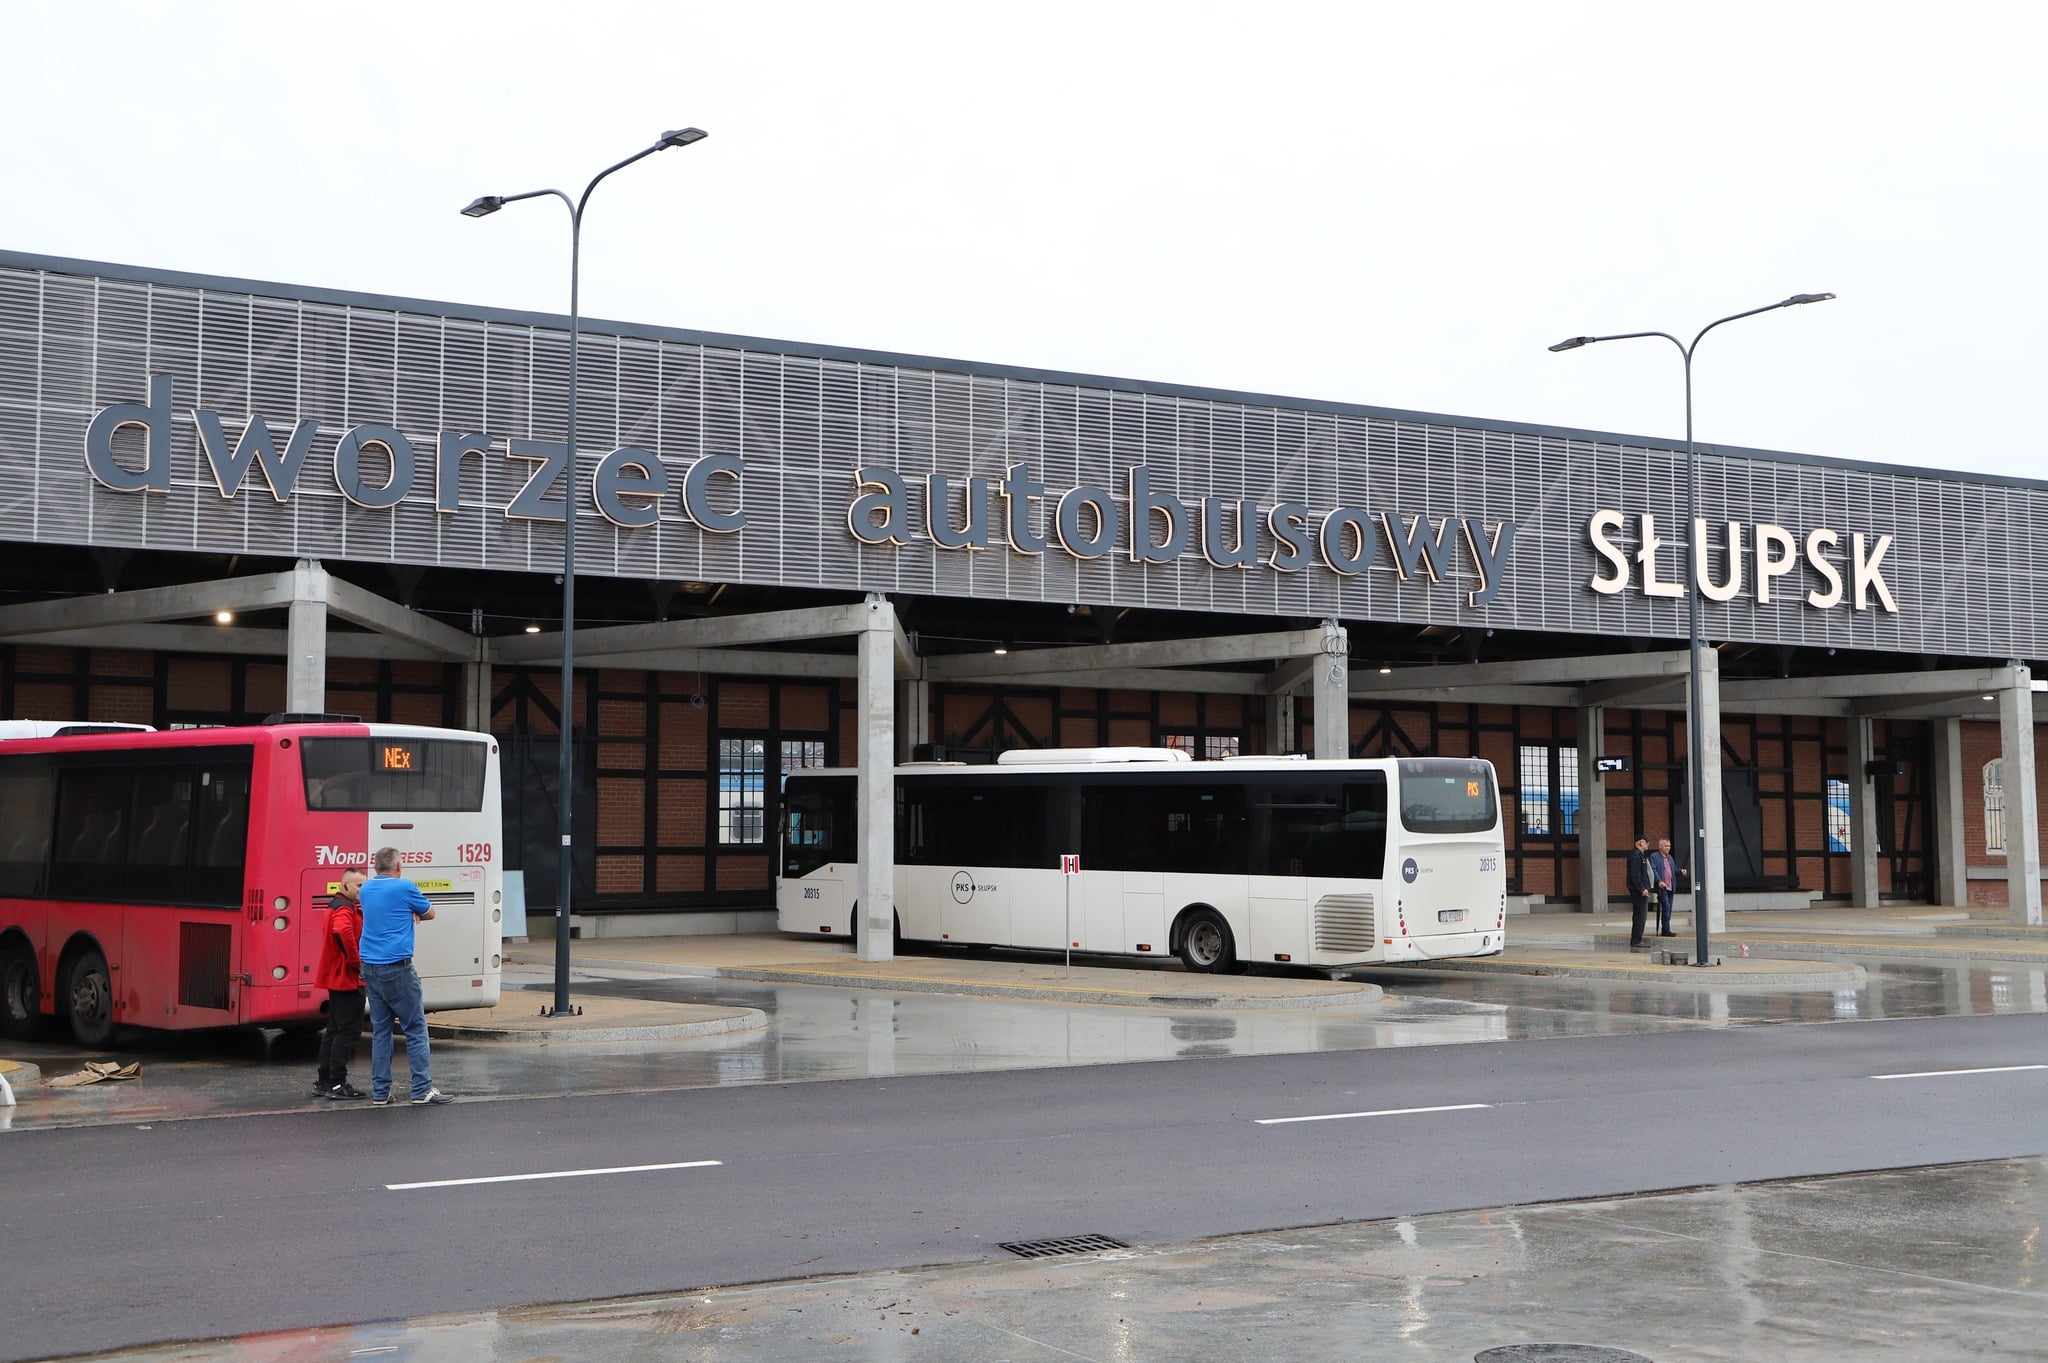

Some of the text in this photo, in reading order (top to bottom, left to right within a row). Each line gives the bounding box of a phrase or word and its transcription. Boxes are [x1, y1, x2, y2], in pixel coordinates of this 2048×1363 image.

[84, 373, 1898, 613] dworzec autobusowy SŁUPSK
[384, 747, 410, 768] NEx
[1467, 782, 1479, 797] PKS
[370, 851, 433, 865] ERESS
[457, 843, 492, 863] 1529
[1404, 867, 1415, 875] PKS
[1479, 857, 1497, 872] 20315
[803, 887, 820, 900] 20315
[955, 883, 970, 892] PKS
